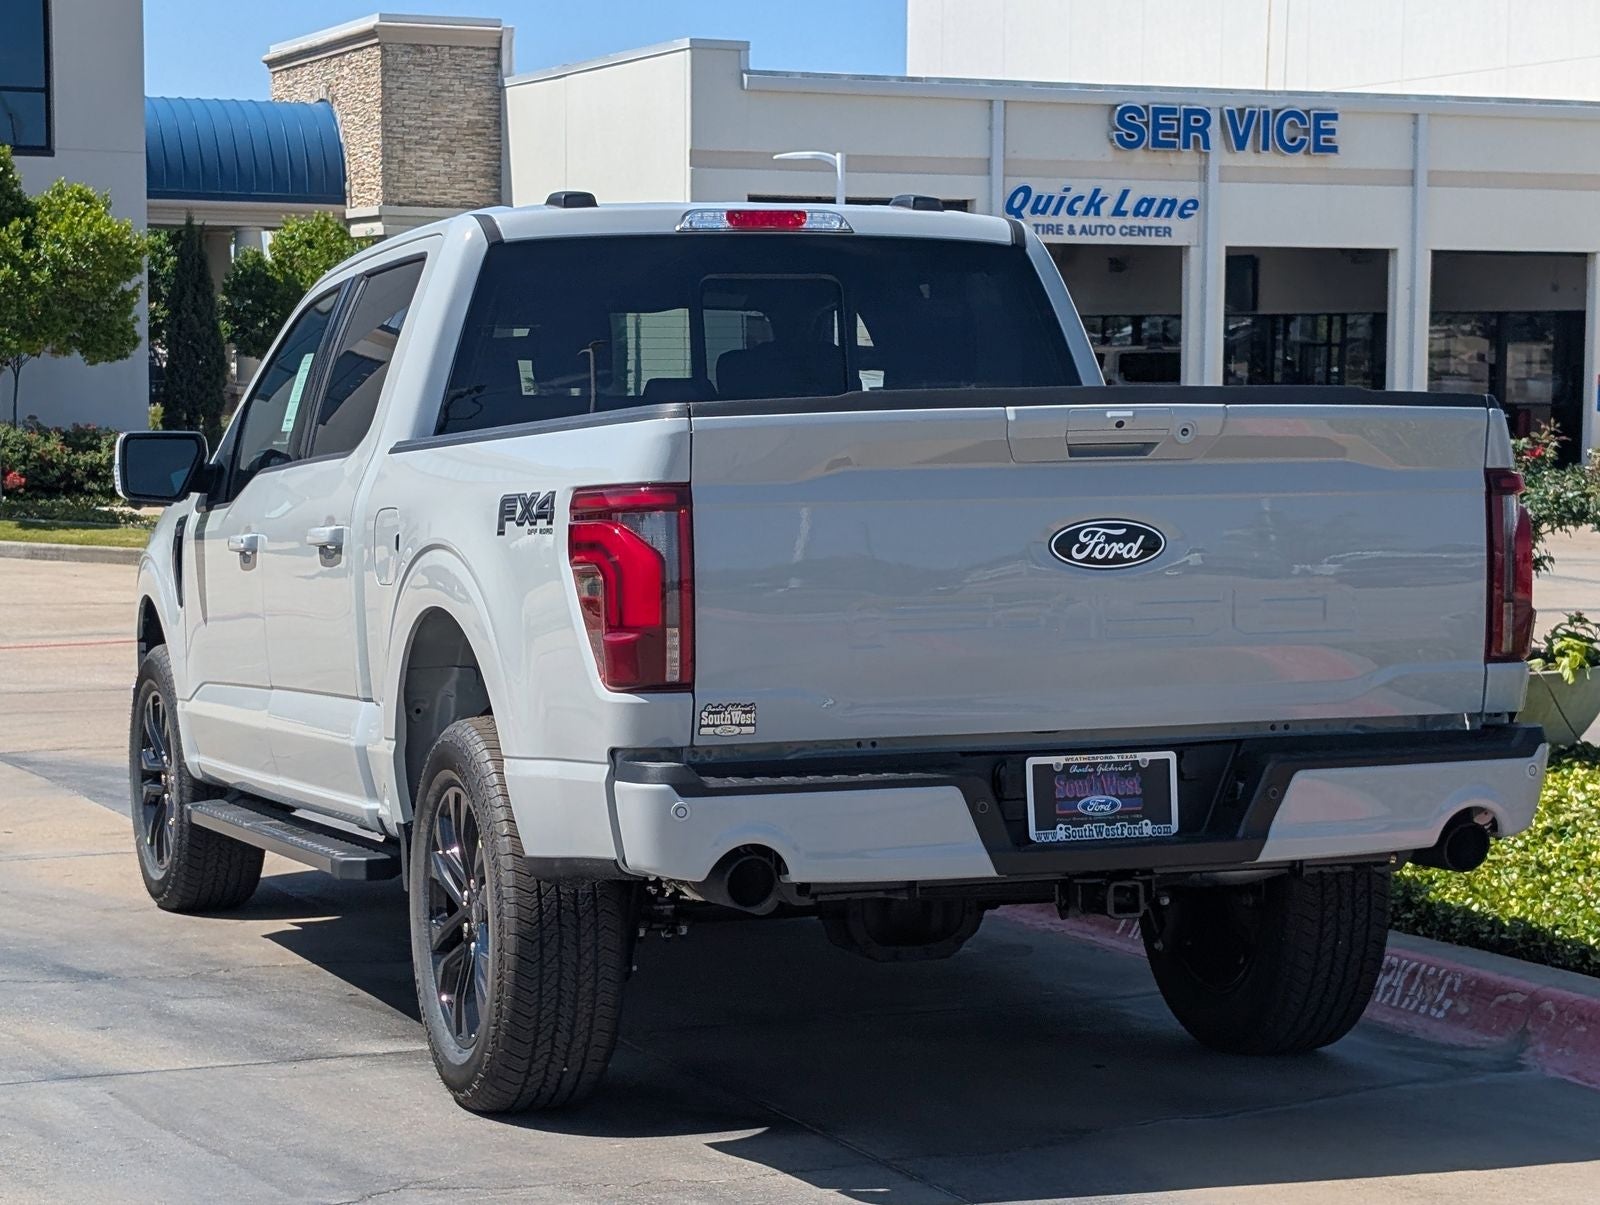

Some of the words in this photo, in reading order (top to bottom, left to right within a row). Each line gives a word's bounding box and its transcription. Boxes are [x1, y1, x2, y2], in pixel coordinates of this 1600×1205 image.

[1005, 185, 1109, 219] Quick
[1111, 189, 1200, 219] Lane
[1033, 223, 1064, 236] TIRE
[1067, 224, 1076, 236] &
[1079, 224, 1116, 237] AUTO
[1119, 225, 1173, 238] CENTER
[497, 491, 557, 536] FX4
[1071, 527, 1146, 560] Ford
[701, 710, 756, 725] SouthWest
[1054, 773, 1142, 798] SouthWest
[1087, 799, 1112, 811] Ford
